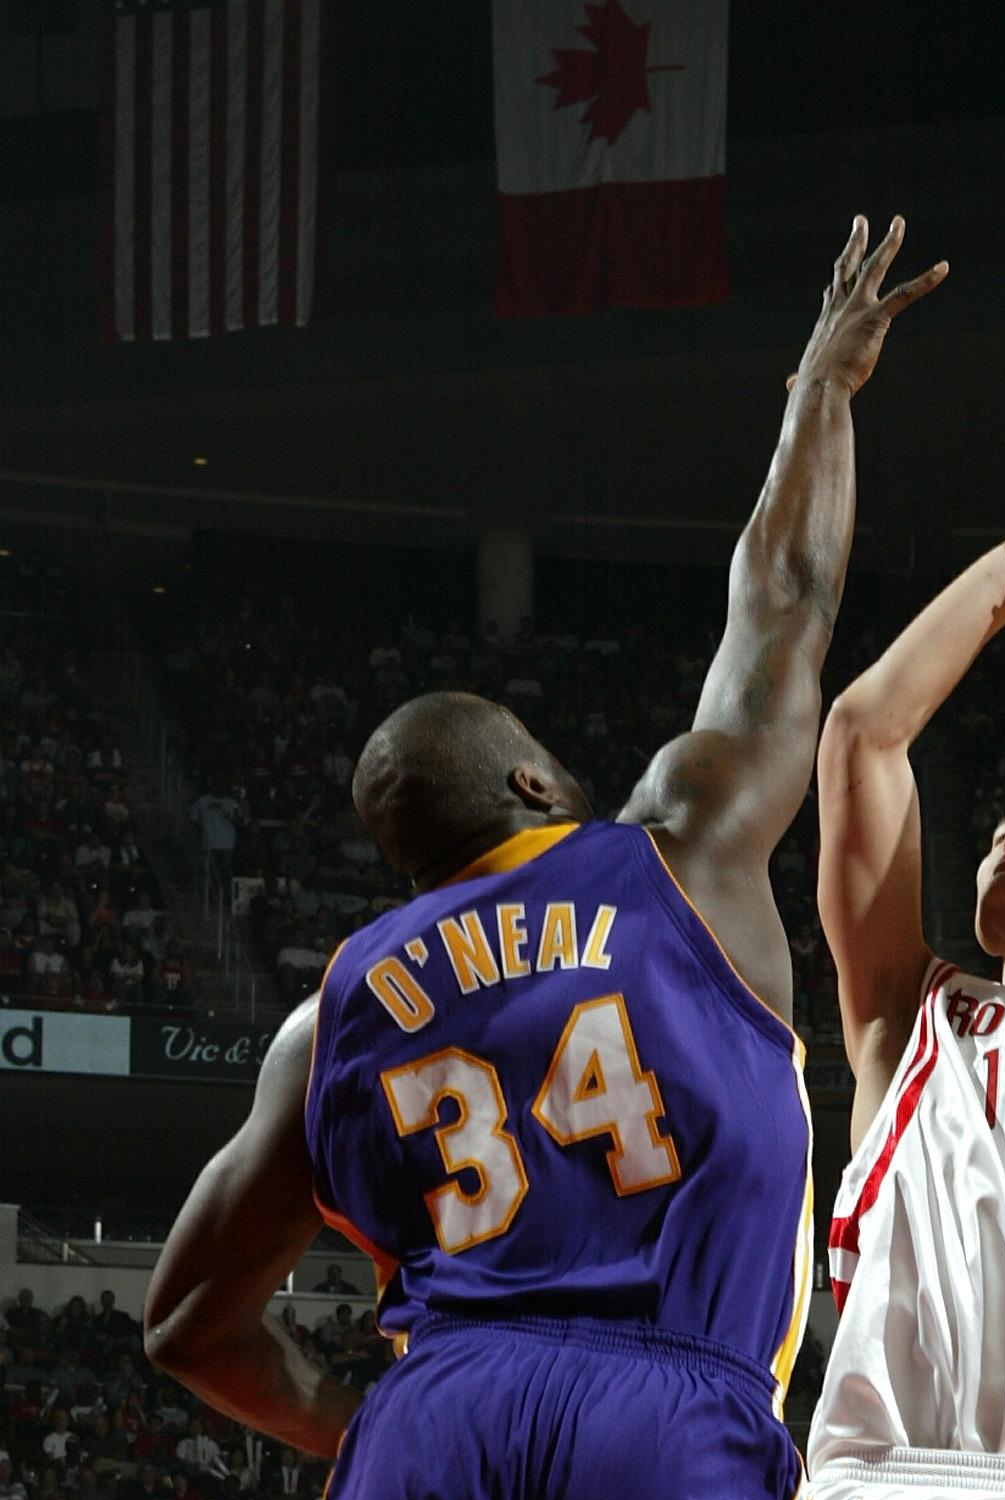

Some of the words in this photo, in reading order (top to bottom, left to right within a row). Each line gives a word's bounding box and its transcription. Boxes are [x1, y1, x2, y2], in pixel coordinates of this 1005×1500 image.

[365, 901, 618, 1034] O'NEAL
[162, 1025, 220, 1061] Vic
[225, 1037, 249, 1064] &
[379, 992, 684, 1256] 34
